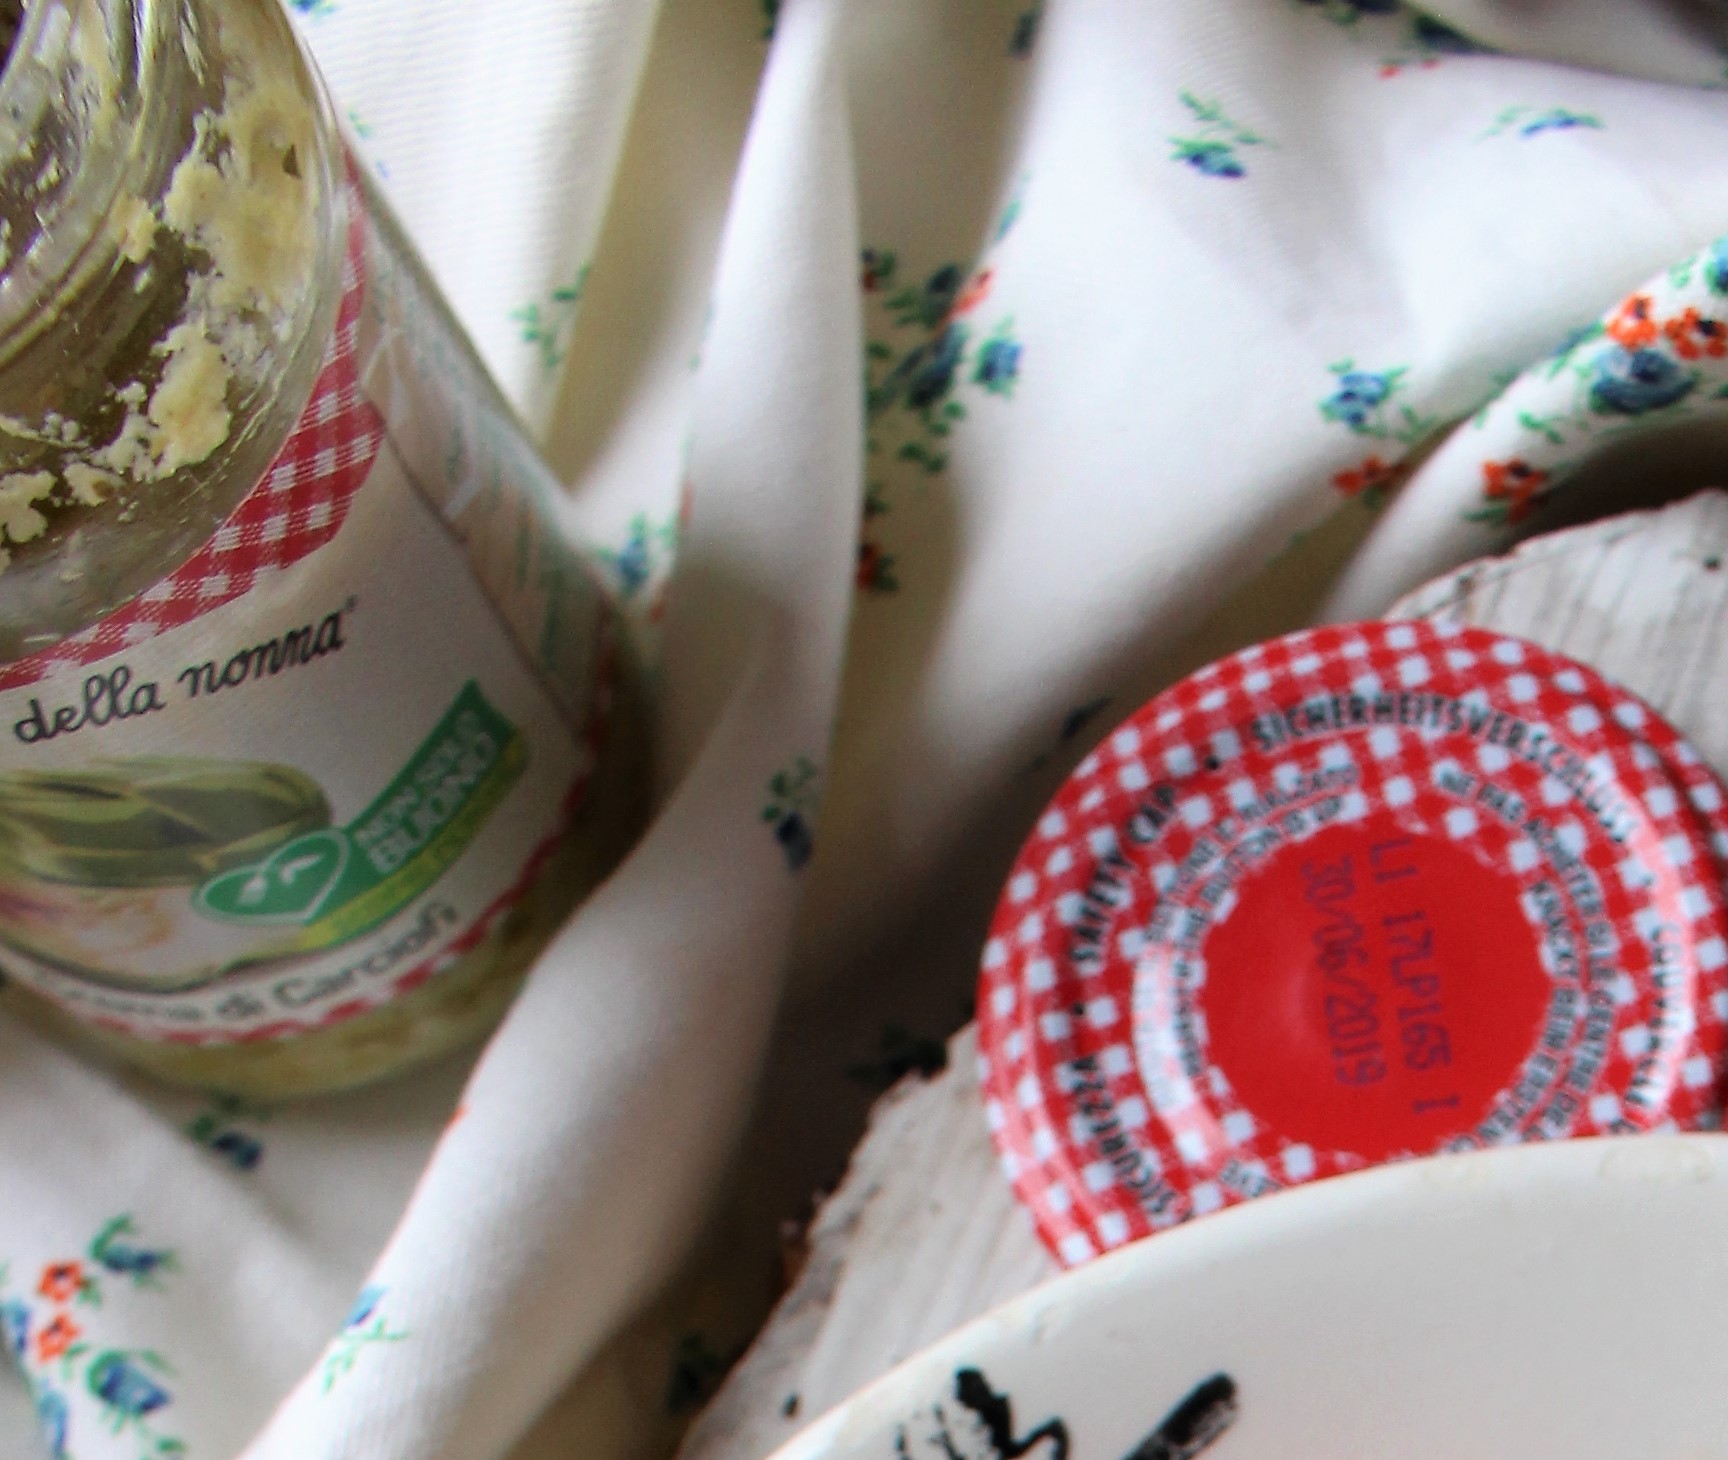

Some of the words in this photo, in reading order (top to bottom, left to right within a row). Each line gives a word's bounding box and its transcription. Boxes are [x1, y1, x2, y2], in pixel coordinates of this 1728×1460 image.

[14, 665, 166, 743] della
[177, 609, 347, 697] nonna
[368, 732, 496, 873] BUONO
[1252, 696, 1634, 843] SICHERHEITSVERSCHLUSS
[1072, 848, 1134, 963] SAFETY
[1128, 785, 1176, 843] CAP
[1300, 853, 1387, 1090] 30/06/2019
[1625, 921, 1685, 1110] COUVERCLE
[1071, 1056, 1178, 1213] SICUREZZA
